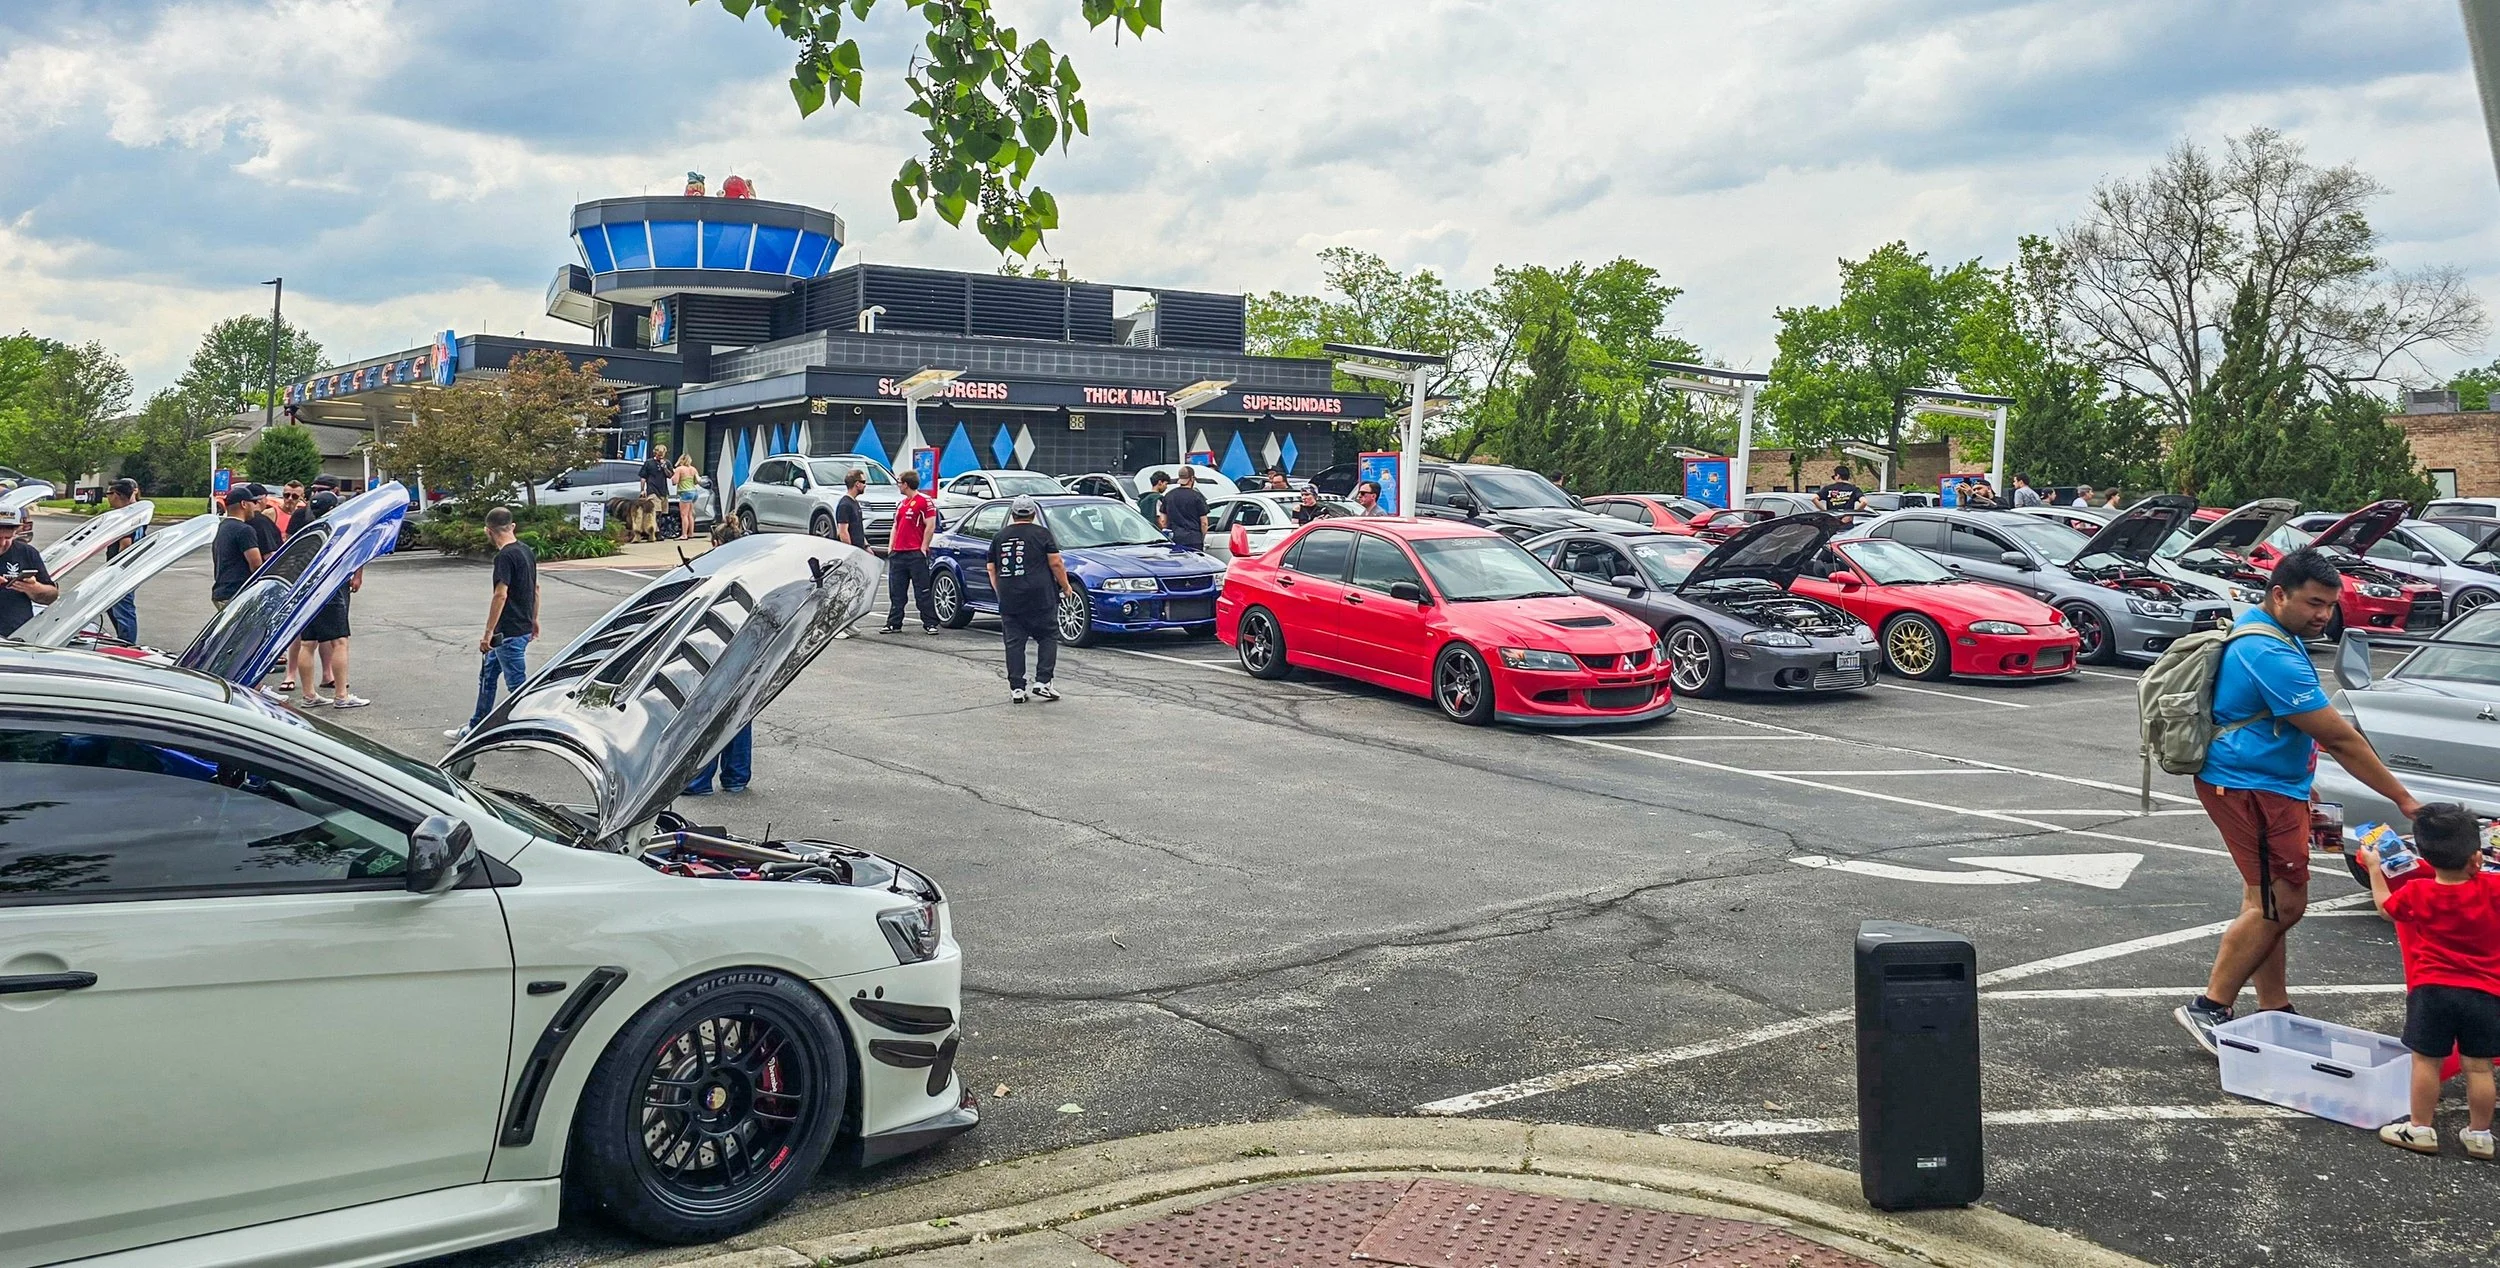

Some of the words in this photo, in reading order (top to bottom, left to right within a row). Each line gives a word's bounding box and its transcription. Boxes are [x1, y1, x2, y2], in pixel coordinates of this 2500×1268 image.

[878, 377, 1008, 399] SUURGERS
[1083, 387, 1128, 404] THICK
[1242, 394, 1342, 413] SUPERSUNDAES
[696, 973, 773, 995] MICHELIN
